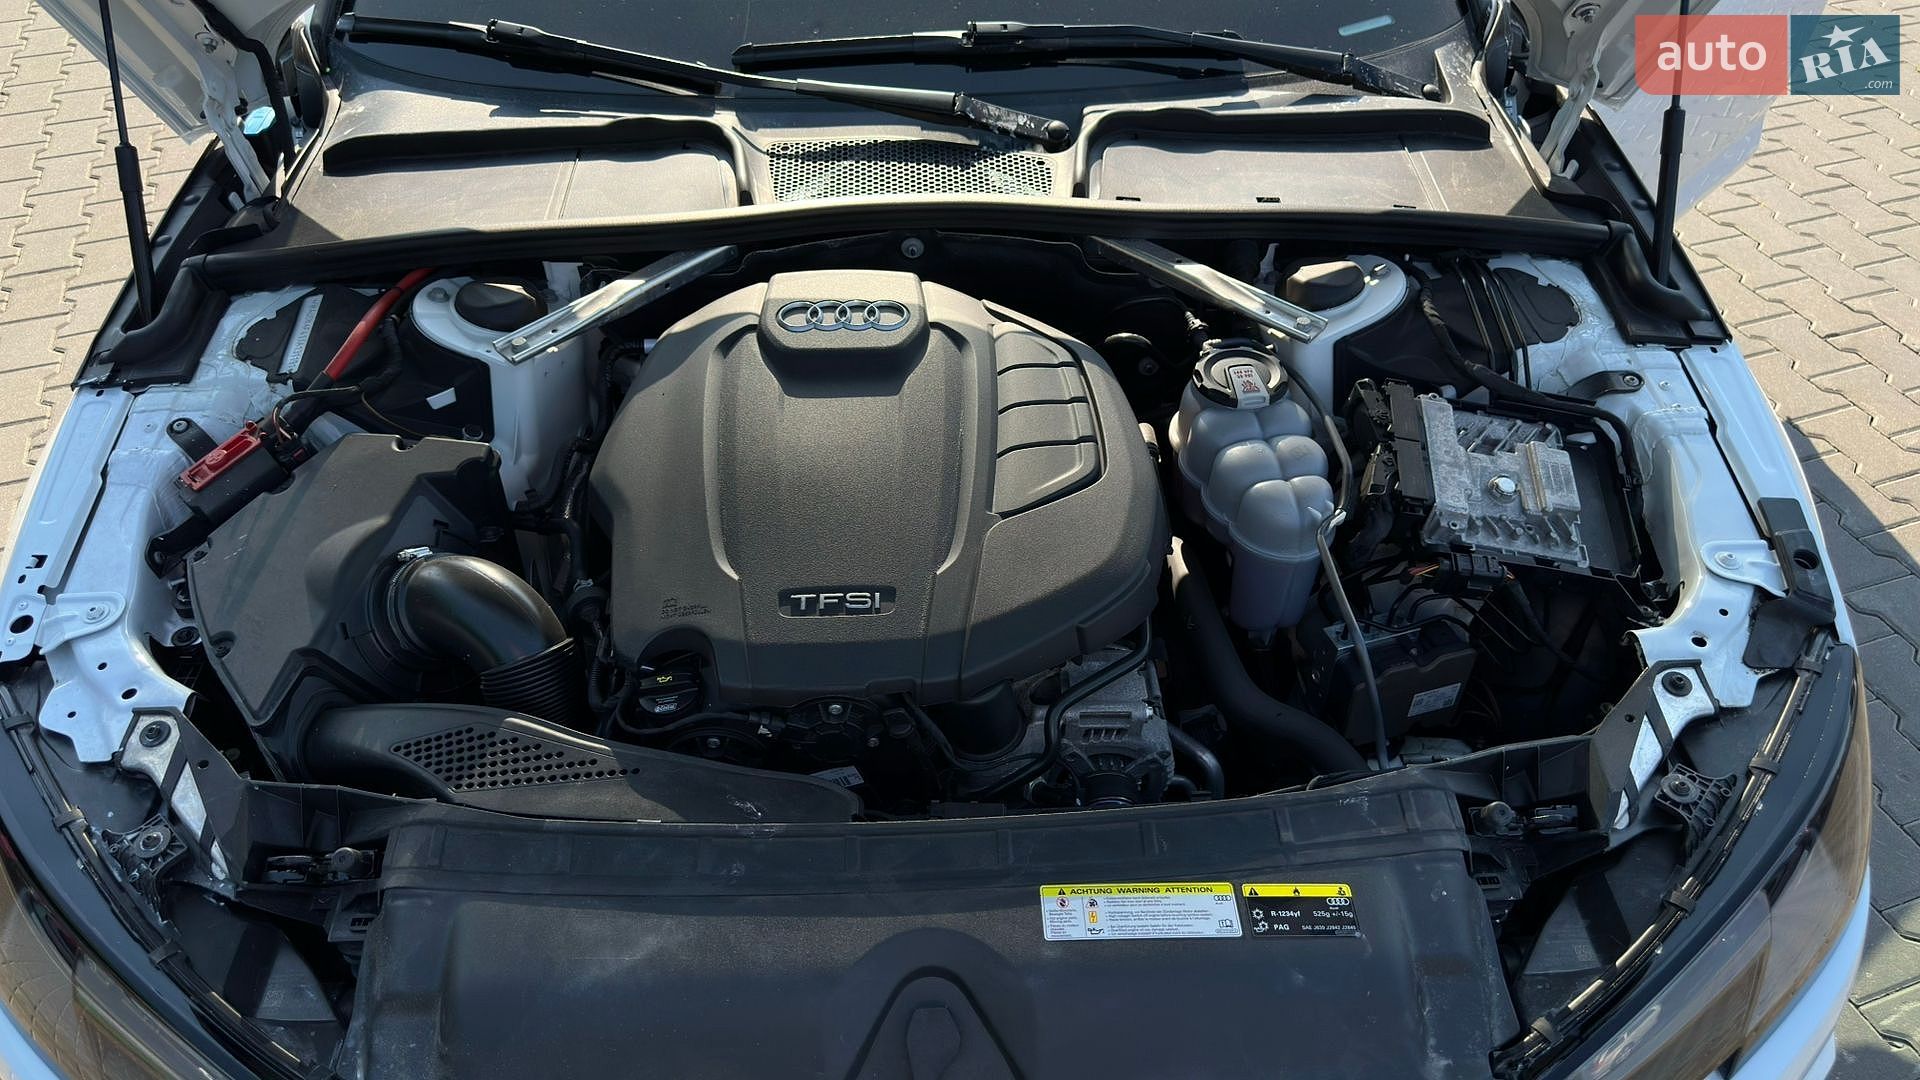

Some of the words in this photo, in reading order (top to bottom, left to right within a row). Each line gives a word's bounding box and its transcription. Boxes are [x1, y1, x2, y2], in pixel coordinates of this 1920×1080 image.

[790, 592, 880, 610] TFSI
[1070, 887, 1112, 895] ACHTUNG
[1270, 910, 1301, 918] R-1234yf
[1313, 910, 1330, 918] 525g
